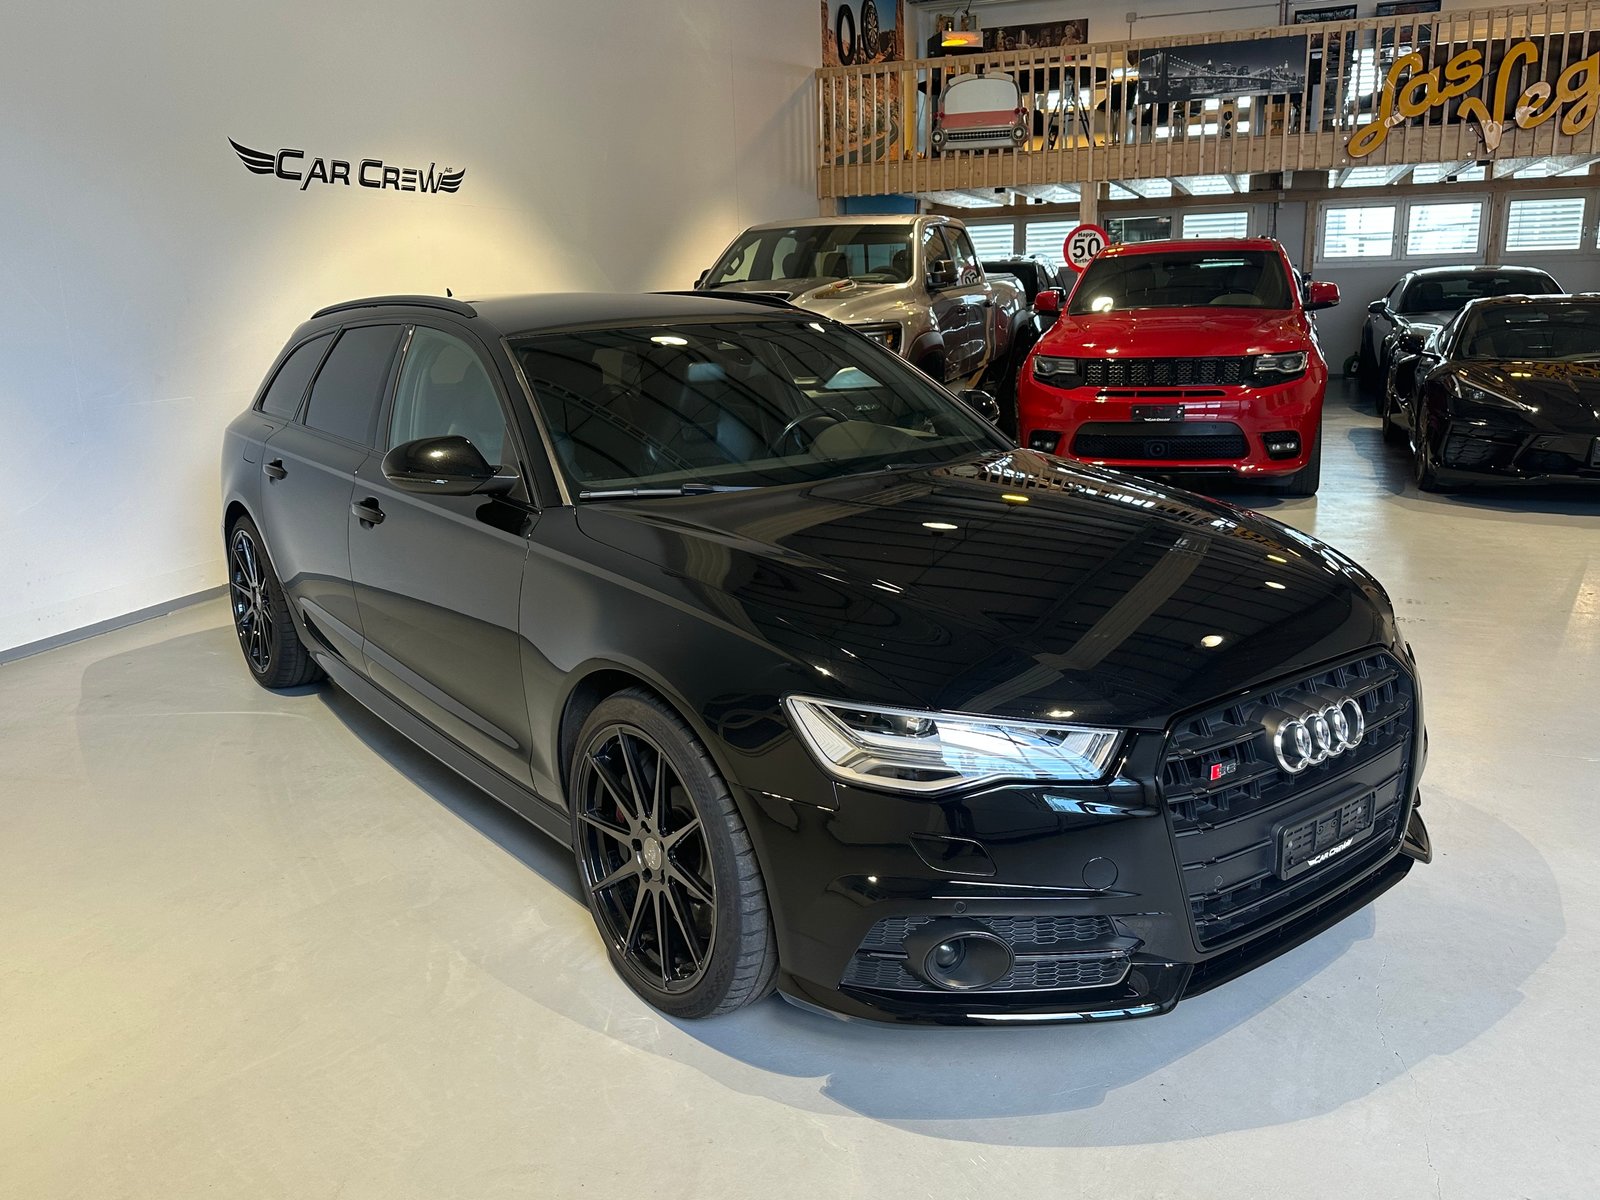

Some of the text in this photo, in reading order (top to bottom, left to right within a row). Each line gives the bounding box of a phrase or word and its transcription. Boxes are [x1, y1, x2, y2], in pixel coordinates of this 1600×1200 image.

[1347, 48, 1484, 158] Las
[274, 148, 350, 191] CAR
[358, 159, 443, 194] CREW
[1072, 238, 1101, 259] 50
